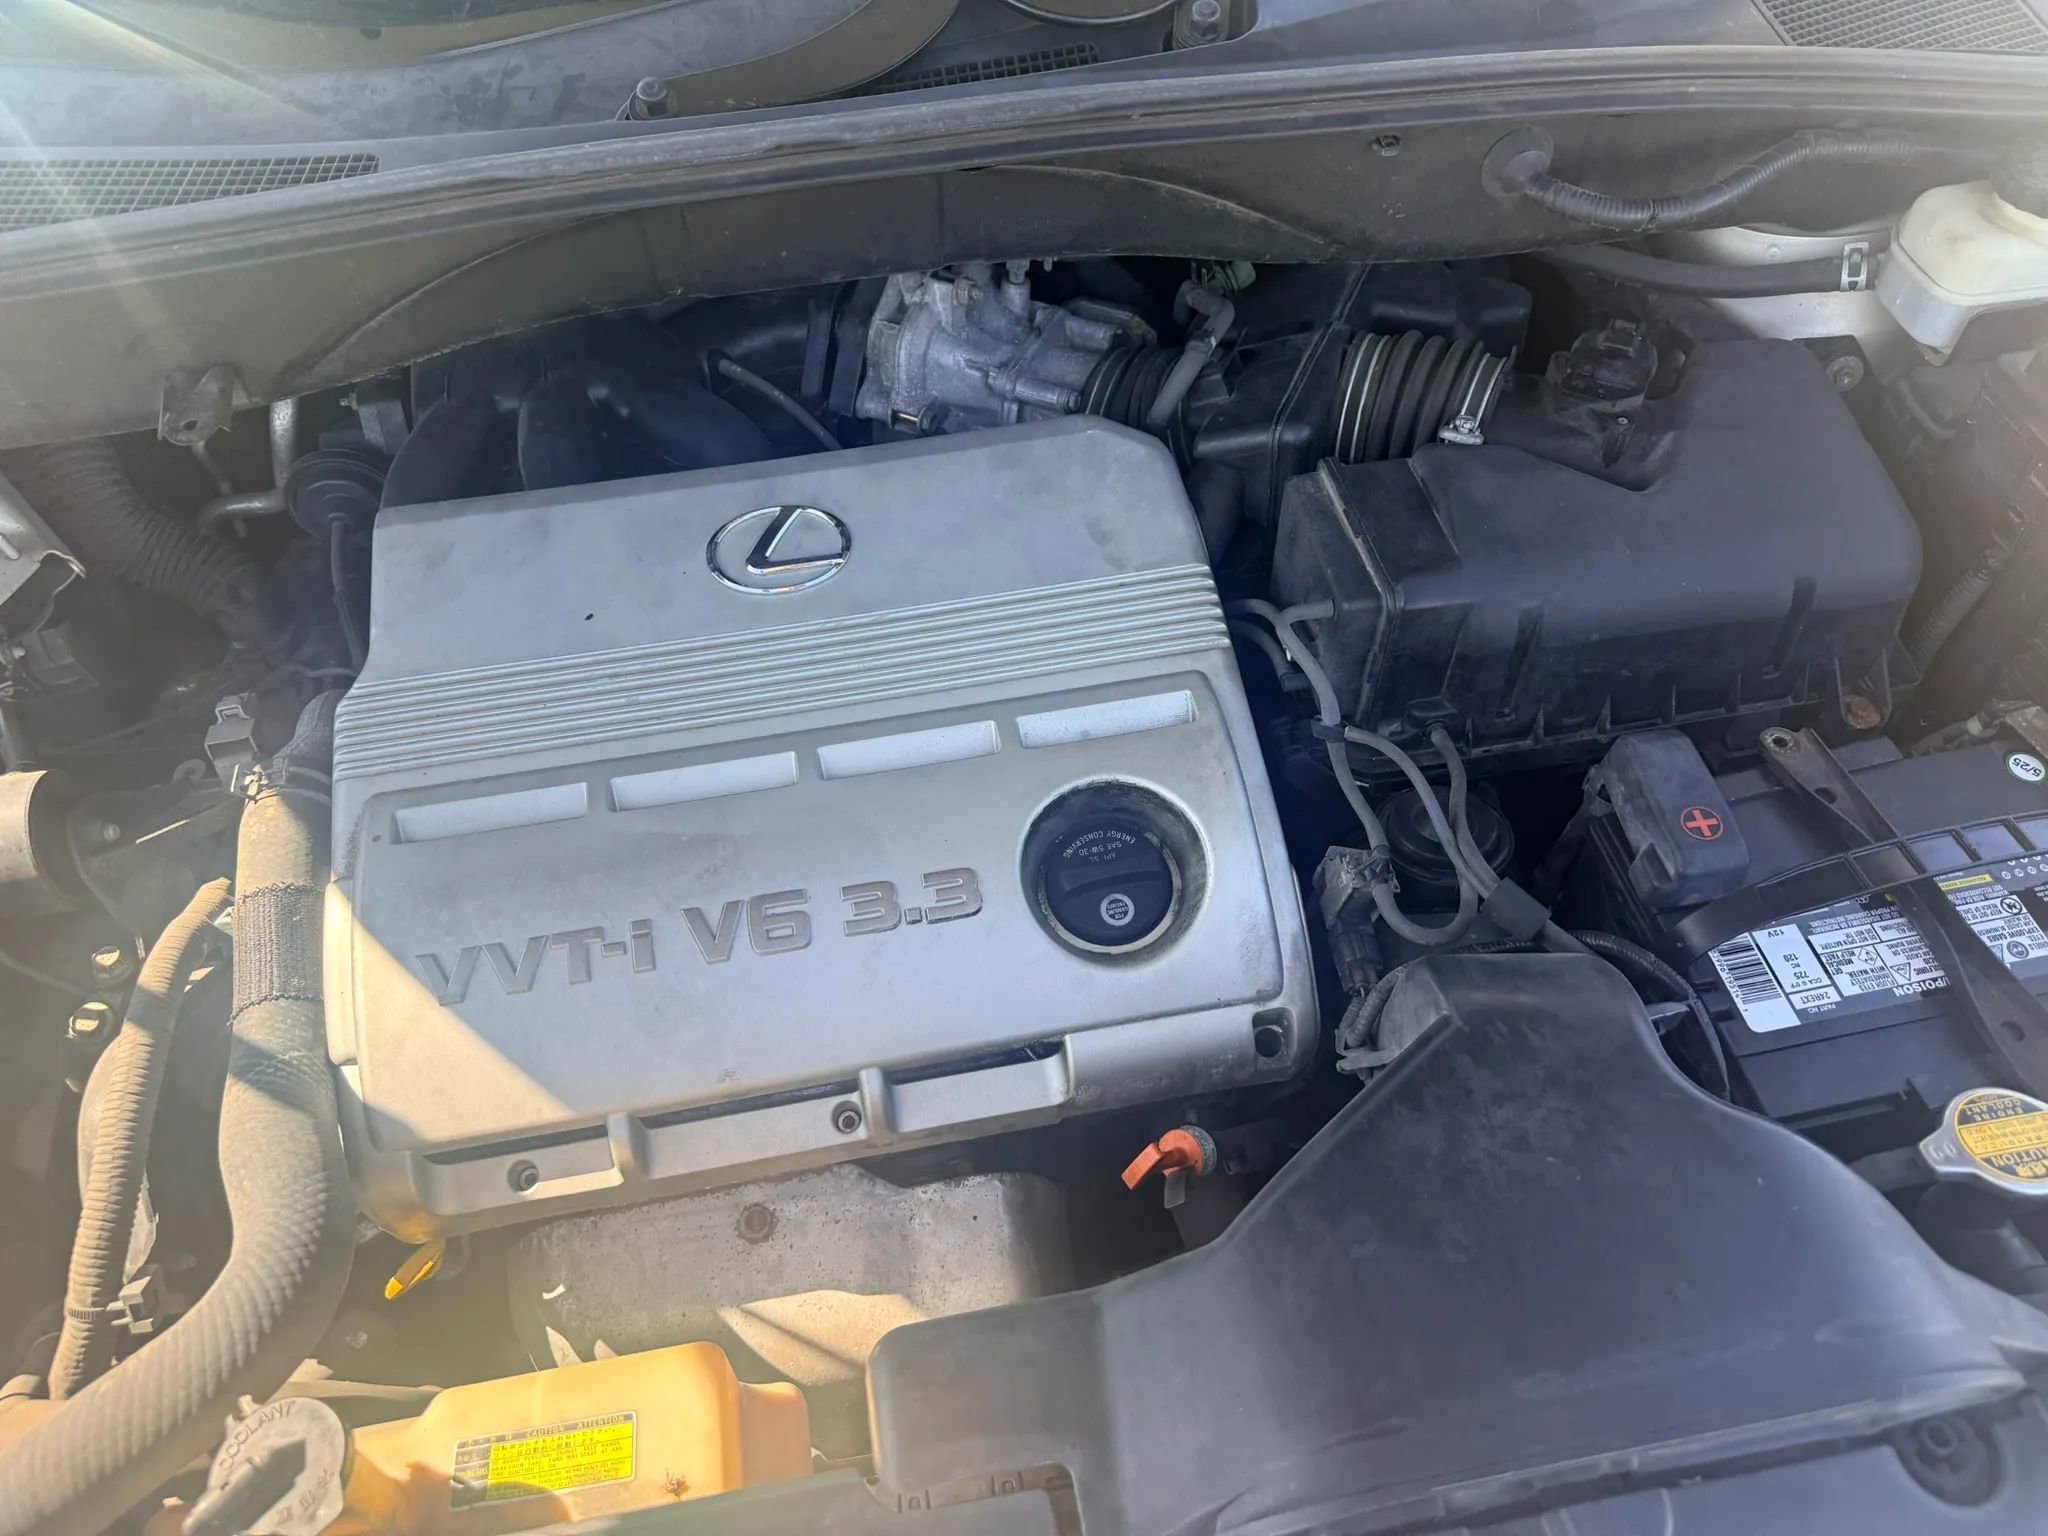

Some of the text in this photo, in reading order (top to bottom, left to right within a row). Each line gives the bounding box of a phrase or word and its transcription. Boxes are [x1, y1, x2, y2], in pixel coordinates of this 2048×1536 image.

[2012, 757, 2042, 777] 5/25
[1063, 830, 1136, 858] ENERGY CONSERVING
[1079, 840, 1122, 856] SAE 5W-30
[1103, 852, 1116, 861] API
[415, 867, 984, 1006] VVT-i V6 3.3
[1766, 928, 1784, 937] 12V
[2007, 926, 2039, 937] EXPLOSIVE
[1842, 937, 1857, 946] OPEN
[1782, 952, 1798, 962] 120
[1839, 949, 1856, 958] HELP
[1826, 957, 1853, 968] MEDICAL
[1792, 970, 1809, 980] 725
[1830, 967, 1843, 975] GET
[1869, 965, 1886, 974] WITH
[1849, 971, 1890, 985] IMMEDIATELY
[1858, 978, 1894, 991] FLUSH EYES
[1799, 991, 1830, 1003] 24REXT
[1965, 1098, 2022, 1116] COOLANT
[1974, 1107, 2024, 1122] ENGINE
[1990, 1147, 2048, 1167] AUTION
[219, 1400, 296, 1471] COOLANT
[527, 1425, 564, 1437] CAUTION
